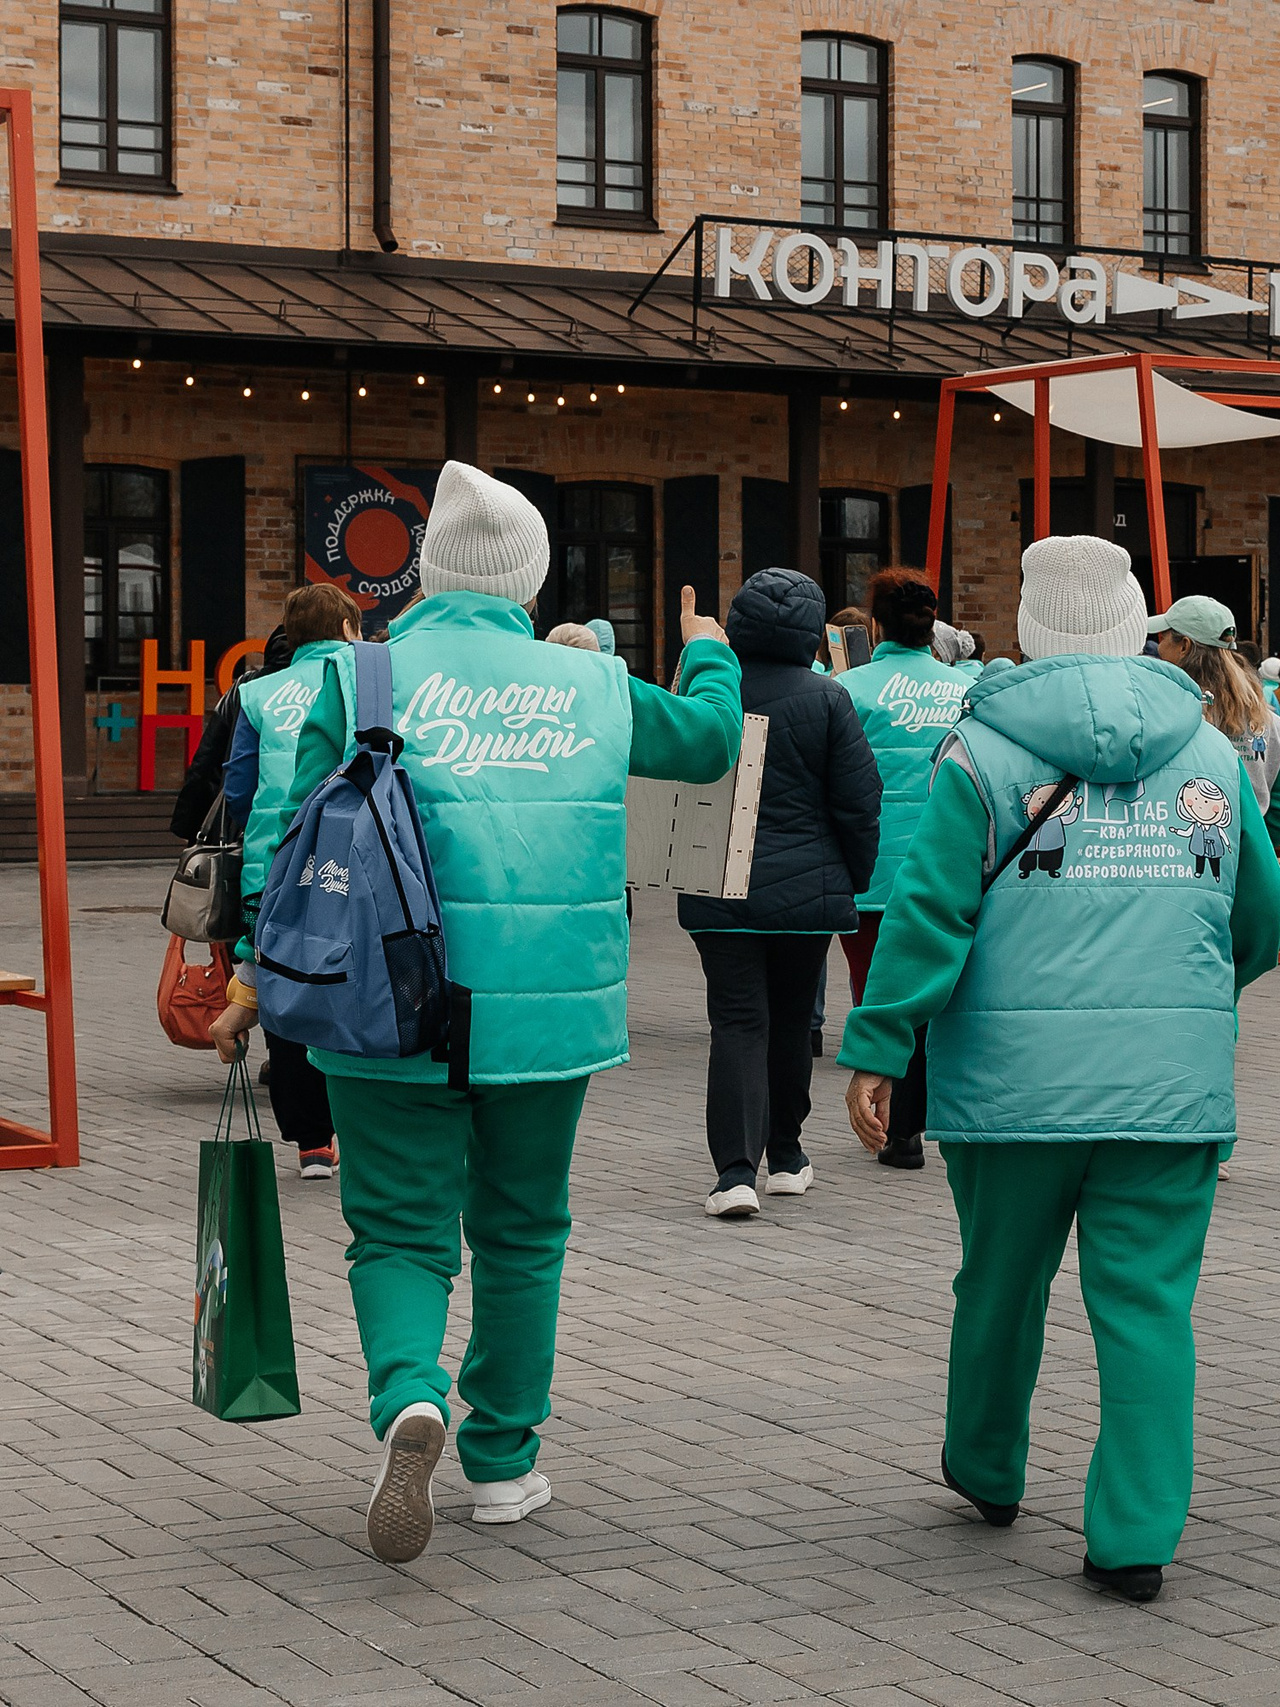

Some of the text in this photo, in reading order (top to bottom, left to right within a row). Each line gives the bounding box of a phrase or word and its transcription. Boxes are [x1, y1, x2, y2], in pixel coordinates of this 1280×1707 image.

[397, 672, 577, 733] Молоды
[415, 718, 596, 776] Душой
[1065, 864, 1194, 879] ДОБРОВОЛЬЧЕСТВА
